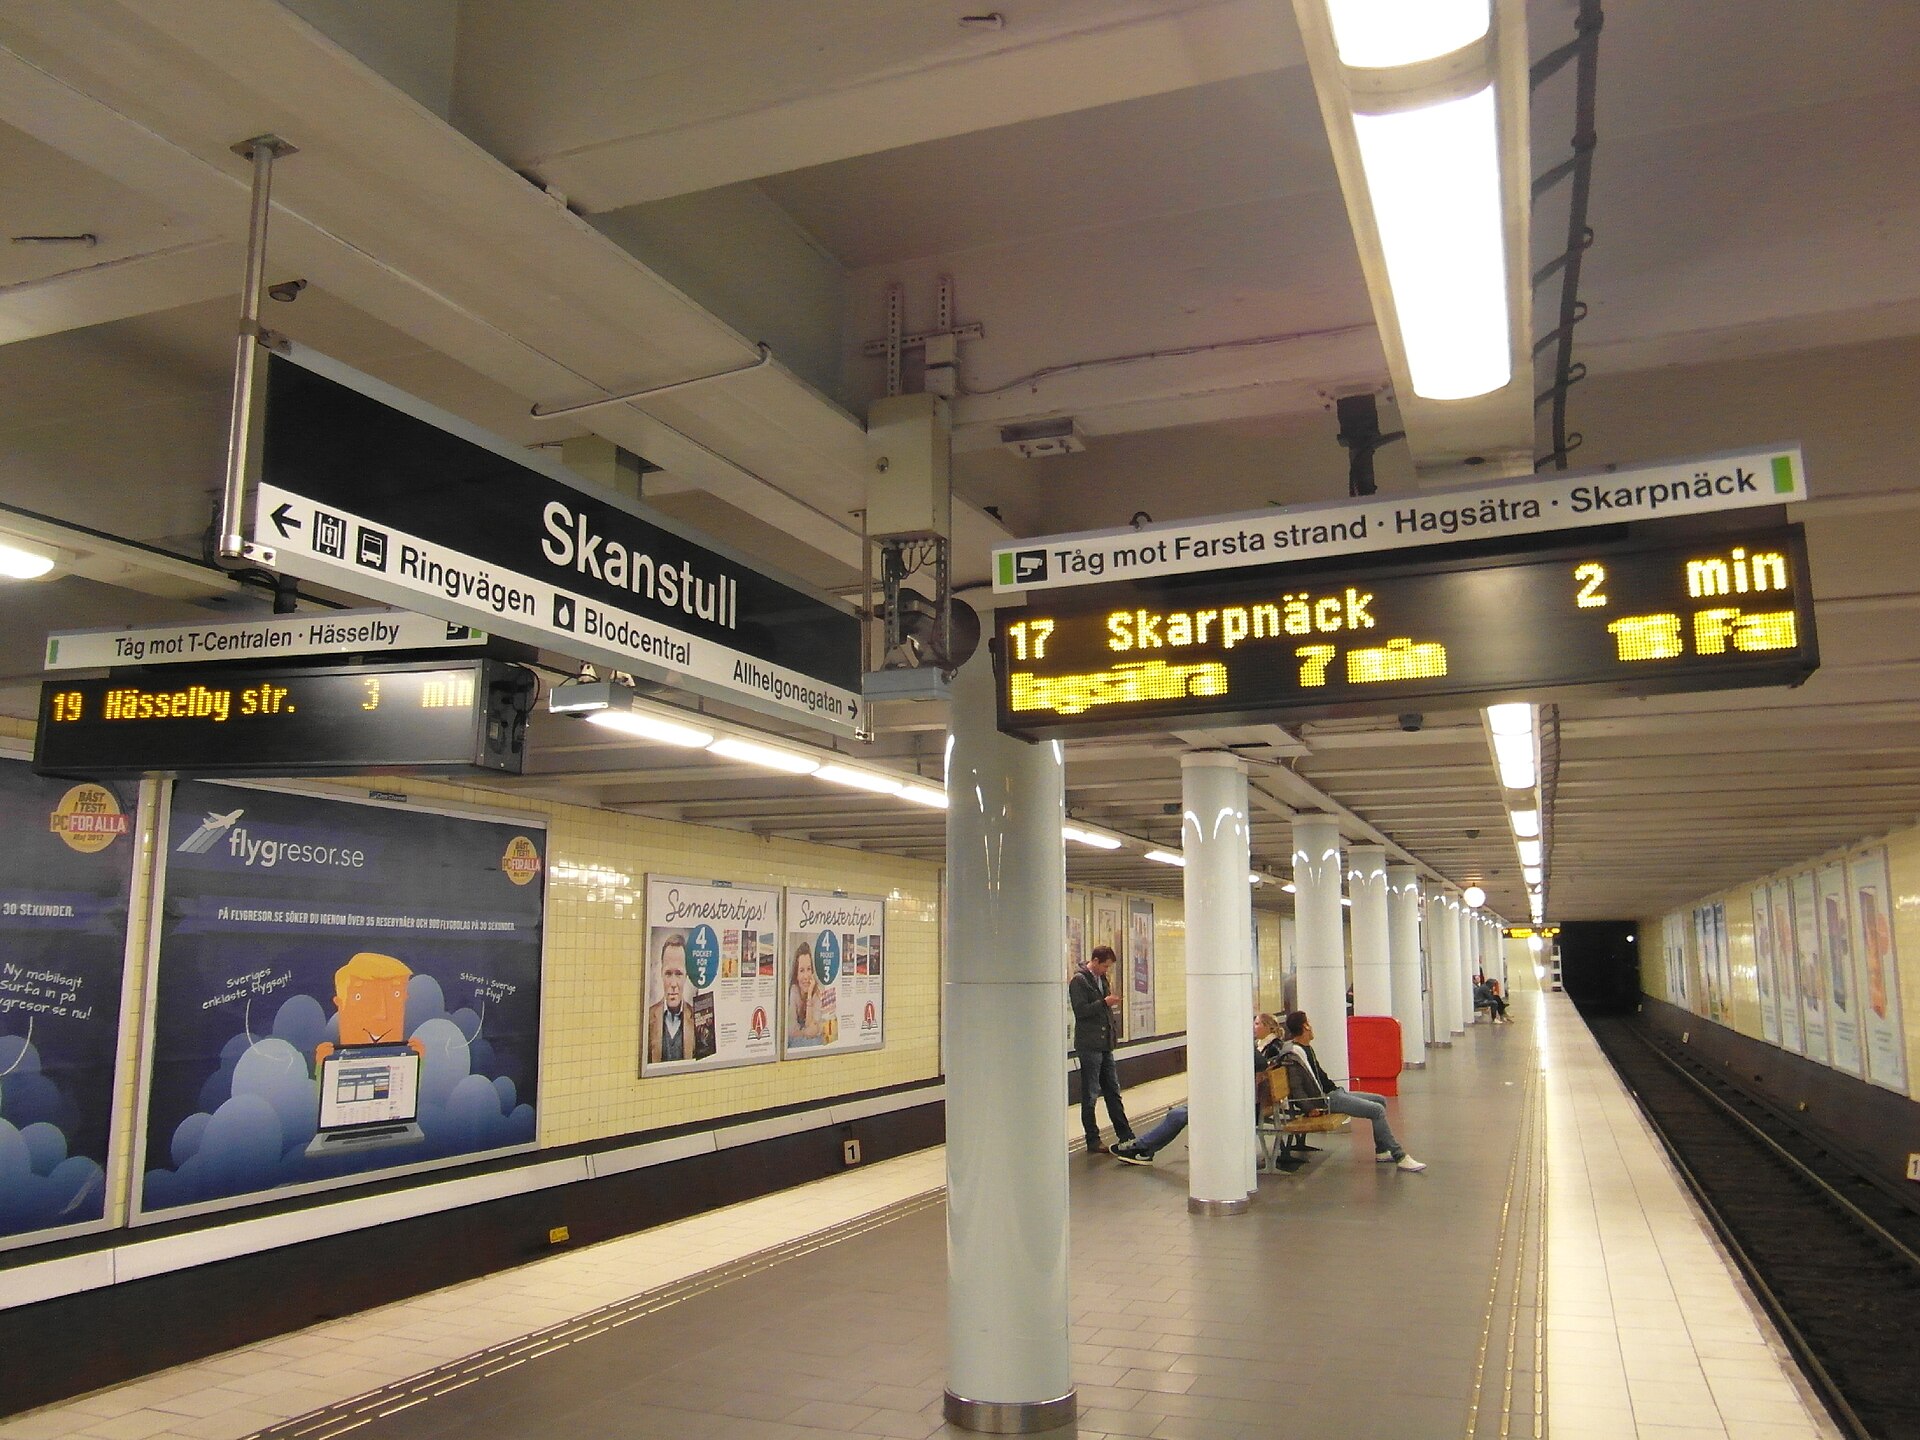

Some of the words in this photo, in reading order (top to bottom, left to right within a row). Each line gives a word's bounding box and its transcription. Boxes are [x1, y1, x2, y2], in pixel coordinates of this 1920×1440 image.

[1055, 548, 1105, 575] Tåg
[1113, 541, 1168, 567] mot
[1175, 530, 1266, 558] Farsta
[1274, 515, 1367, 547] strand
[1395, 500, 1541, 534] Hagsätra
[1570, 467, 1758, 512] Skarpnäck
[541, 500, 738, 630] Skanstull
[1009, 618, 1056, 661] 17
[1107, 587, 1376, 653] Skarpnäck
[1574, 562, 1608, 610] 2
[1685, 546, 1788, 599] min
[115, 637, 145, 660] Tåg
[150, 635, 184, 654] mot
[188, 629, 292, 652] T-Centralen
[309, 621, 400, 645] Hässelby
[400, 544, 536, 616] Ringvägen
[584, 608, 691, 667] Blodcentral
[733, 659, 842, 716] Allhelgonagatan
[54, 692, 82, 722] 19
[105, 685, 230, 723] Hässelby
[241, 682, 296, 717] str.
[362, 678, 380, 711] 3
[228, 827, 365, 868] flygresor.se
[2, 902, 17, 915] 30
[665, 888, 768, 928] Semestertips!
[799, 899, 876, 933] Semestertips!
[695, 926, 707, 949] 4
[821, 931, 831, 952] 4
[692, 950, 713, 958] POCKET
[3, 962, 23, 981] Ny
[226, 967, 272, 989] Sveriges
[697, 966, 706, 986] 3
[823, 965, 831, 983] 3
[0, 979, 40, 996] Surfa
[71, 1005, 93, 1021] nu!
[847, 1143, 856, 1161] 1
